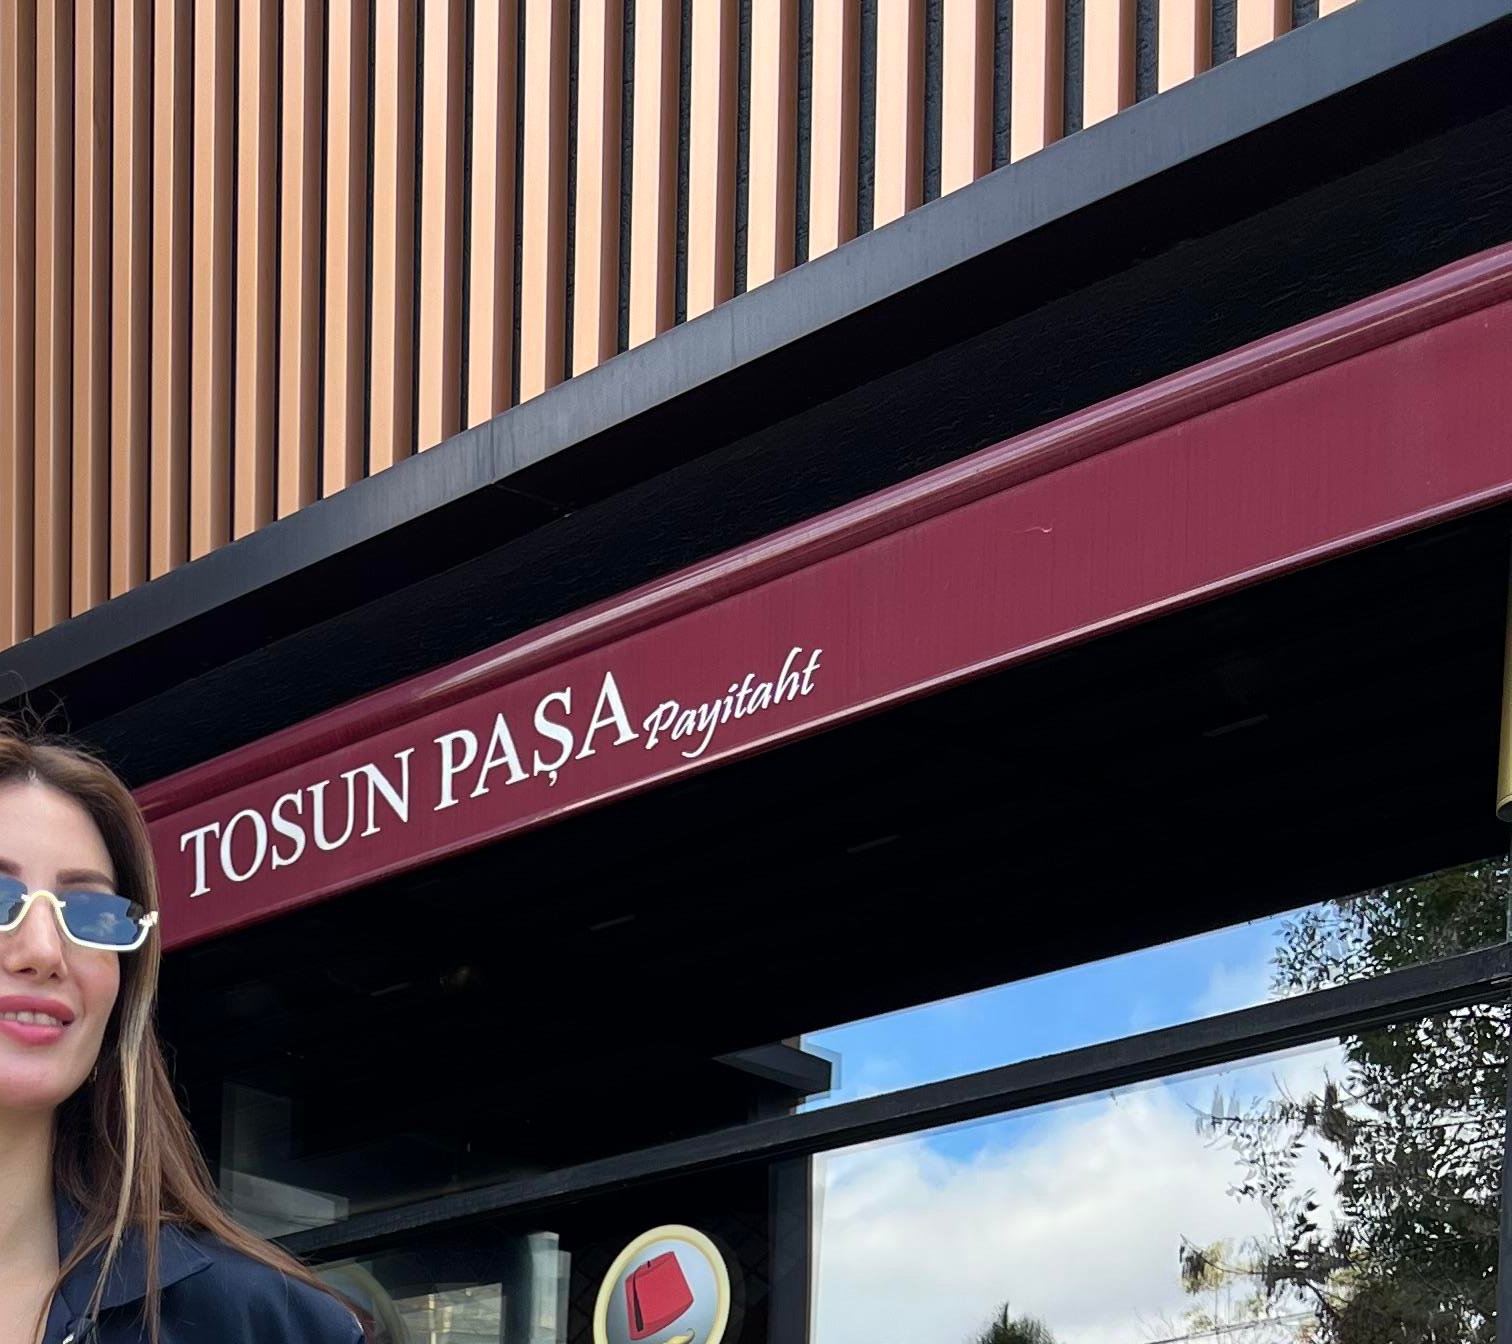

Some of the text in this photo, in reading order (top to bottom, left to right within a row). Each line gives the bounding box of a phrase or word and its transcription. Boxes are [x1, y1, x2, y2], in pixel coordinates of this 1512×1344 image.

[180, 646, 823, 898] TOSUN PAŞA Payitaht
